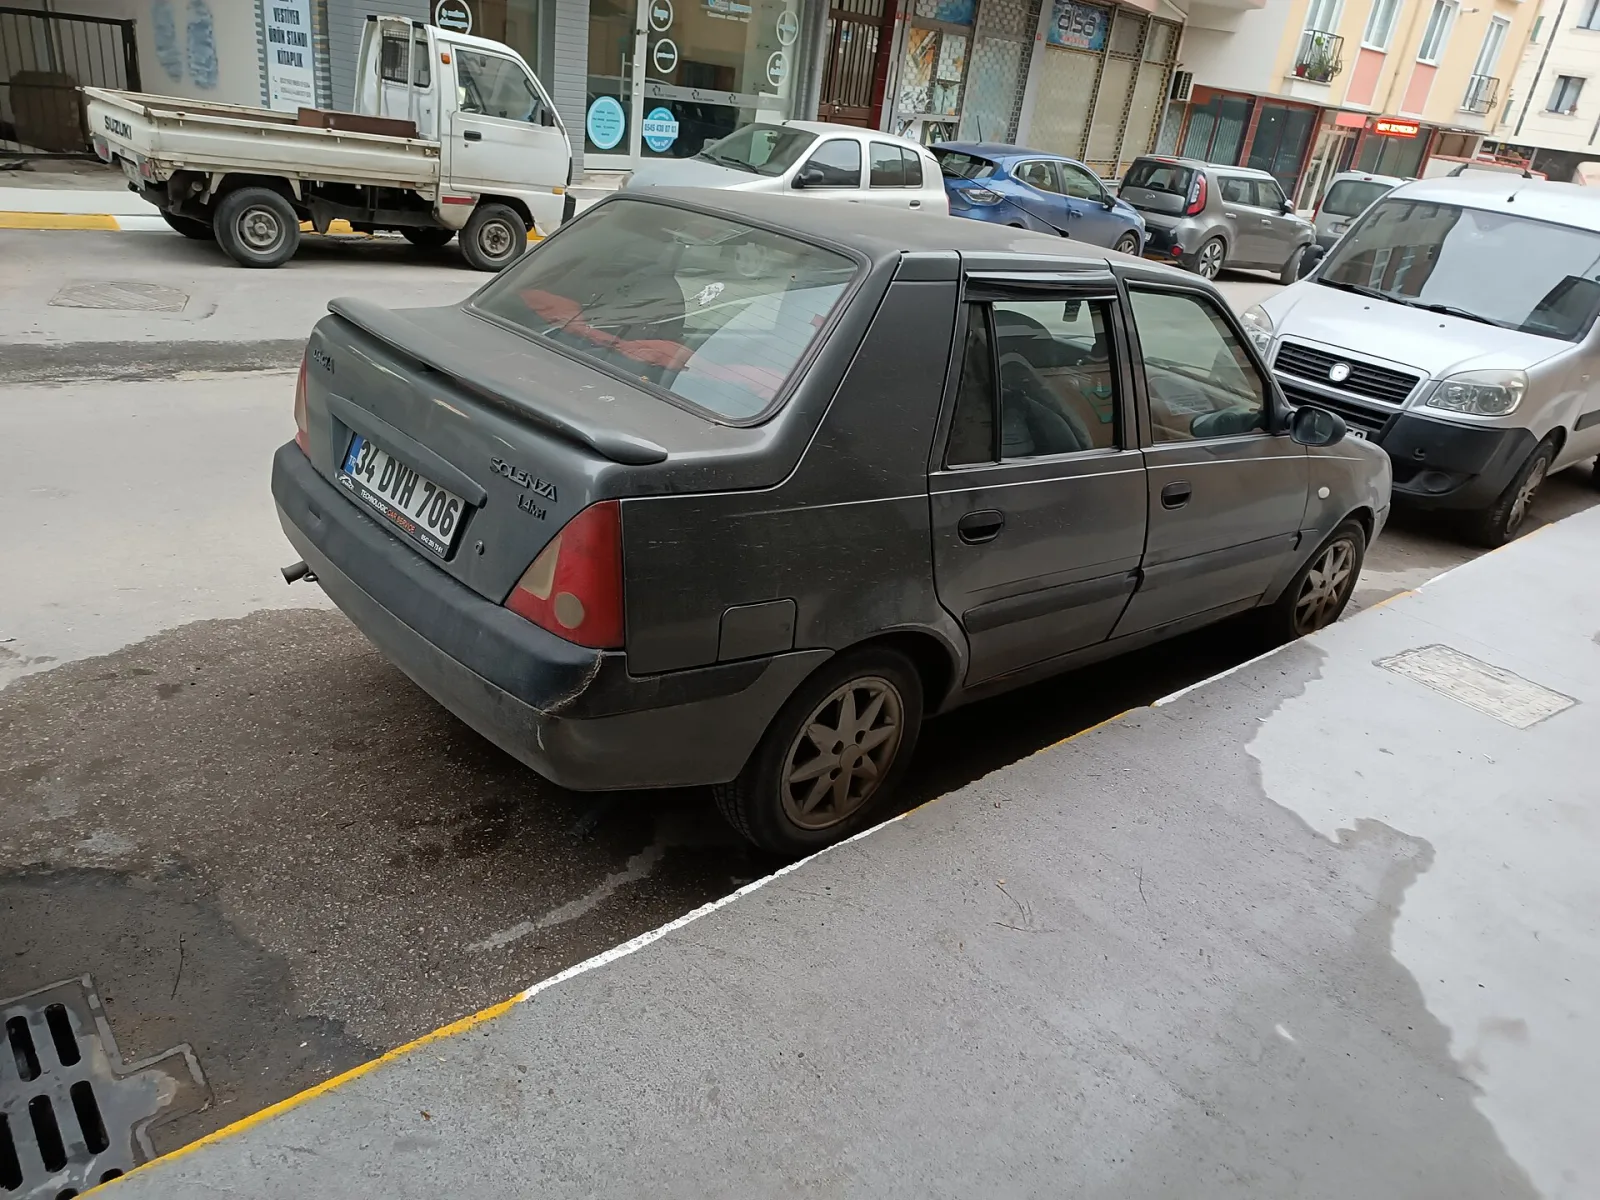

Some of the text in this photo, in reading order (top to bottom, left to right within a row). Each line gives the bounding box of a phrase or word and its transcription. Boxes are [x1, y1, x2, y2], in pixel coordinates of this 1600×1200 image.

[268, 25, 308, 48] ÜRÜN STANDI
[277, 48, 303, 68] KİTAPLIK
[104, 115, 132, 140] SUZUKI
[348, 454, 358, 470] TR
[355, 441, 459, 537] 34 DVH 706
[490, 457, 558, 504] SOLENZA
[360, 489, 416, 535] TECHNOLOGIC CAR SERVICE
